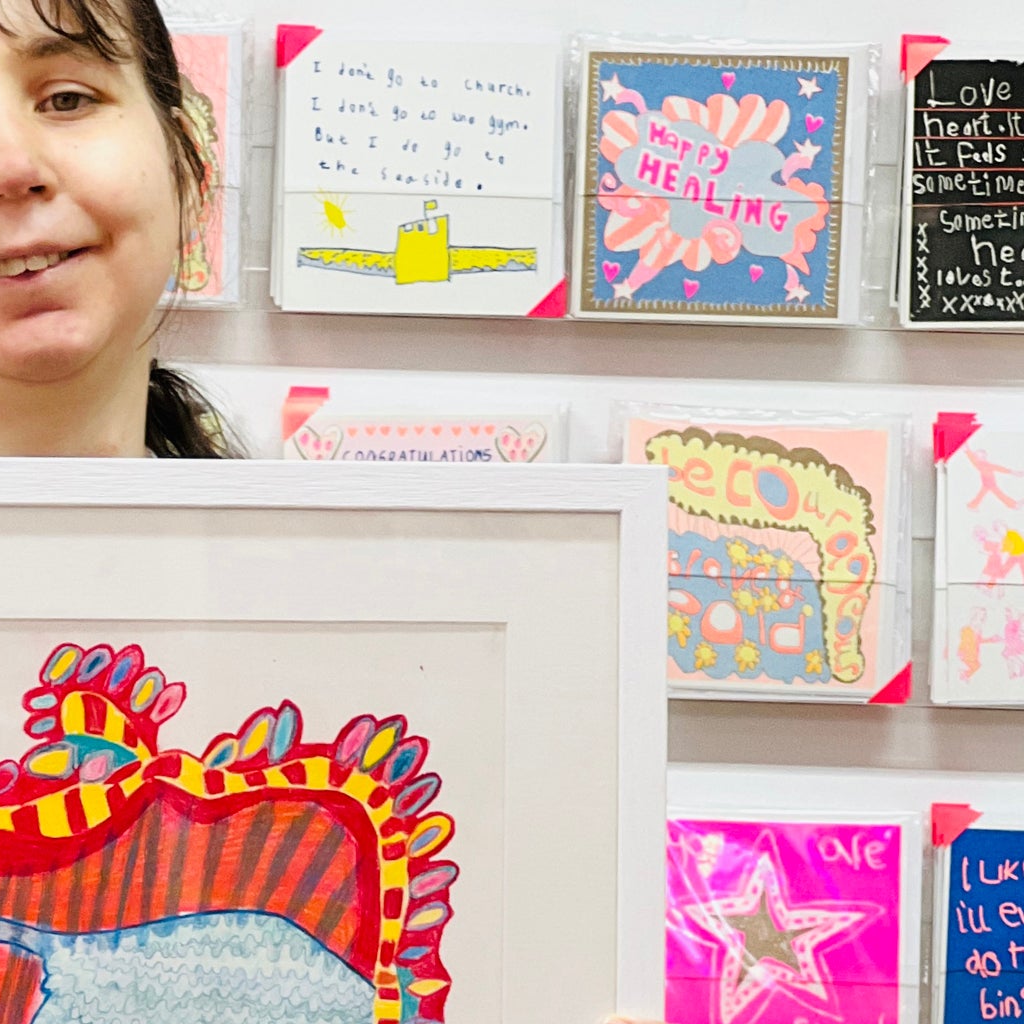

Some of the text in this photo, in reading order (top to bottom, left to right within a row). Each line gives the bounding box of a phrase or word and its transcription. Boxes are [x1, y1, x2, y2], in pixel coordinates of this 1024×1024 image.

[314, 60, 321, 73] I
[386, 67, 403, 88] go
[420, 76, 438, 88] to
[926, 69, 1012, 108] Love
[311, 96, 322, 111] I
[392, 105, 407, 122] go
[421, 110, 436, 120] to
[488, 115, 529, 136] gym.
[315, 126, 504, 164] But I do go to
[915, 139, 947, 167] It
[318, 160, 359, 175] the
[637, 153, 789, 234] HEALING
[818, 836, 887, 871] are
[965, 948, 1001, 978] do
